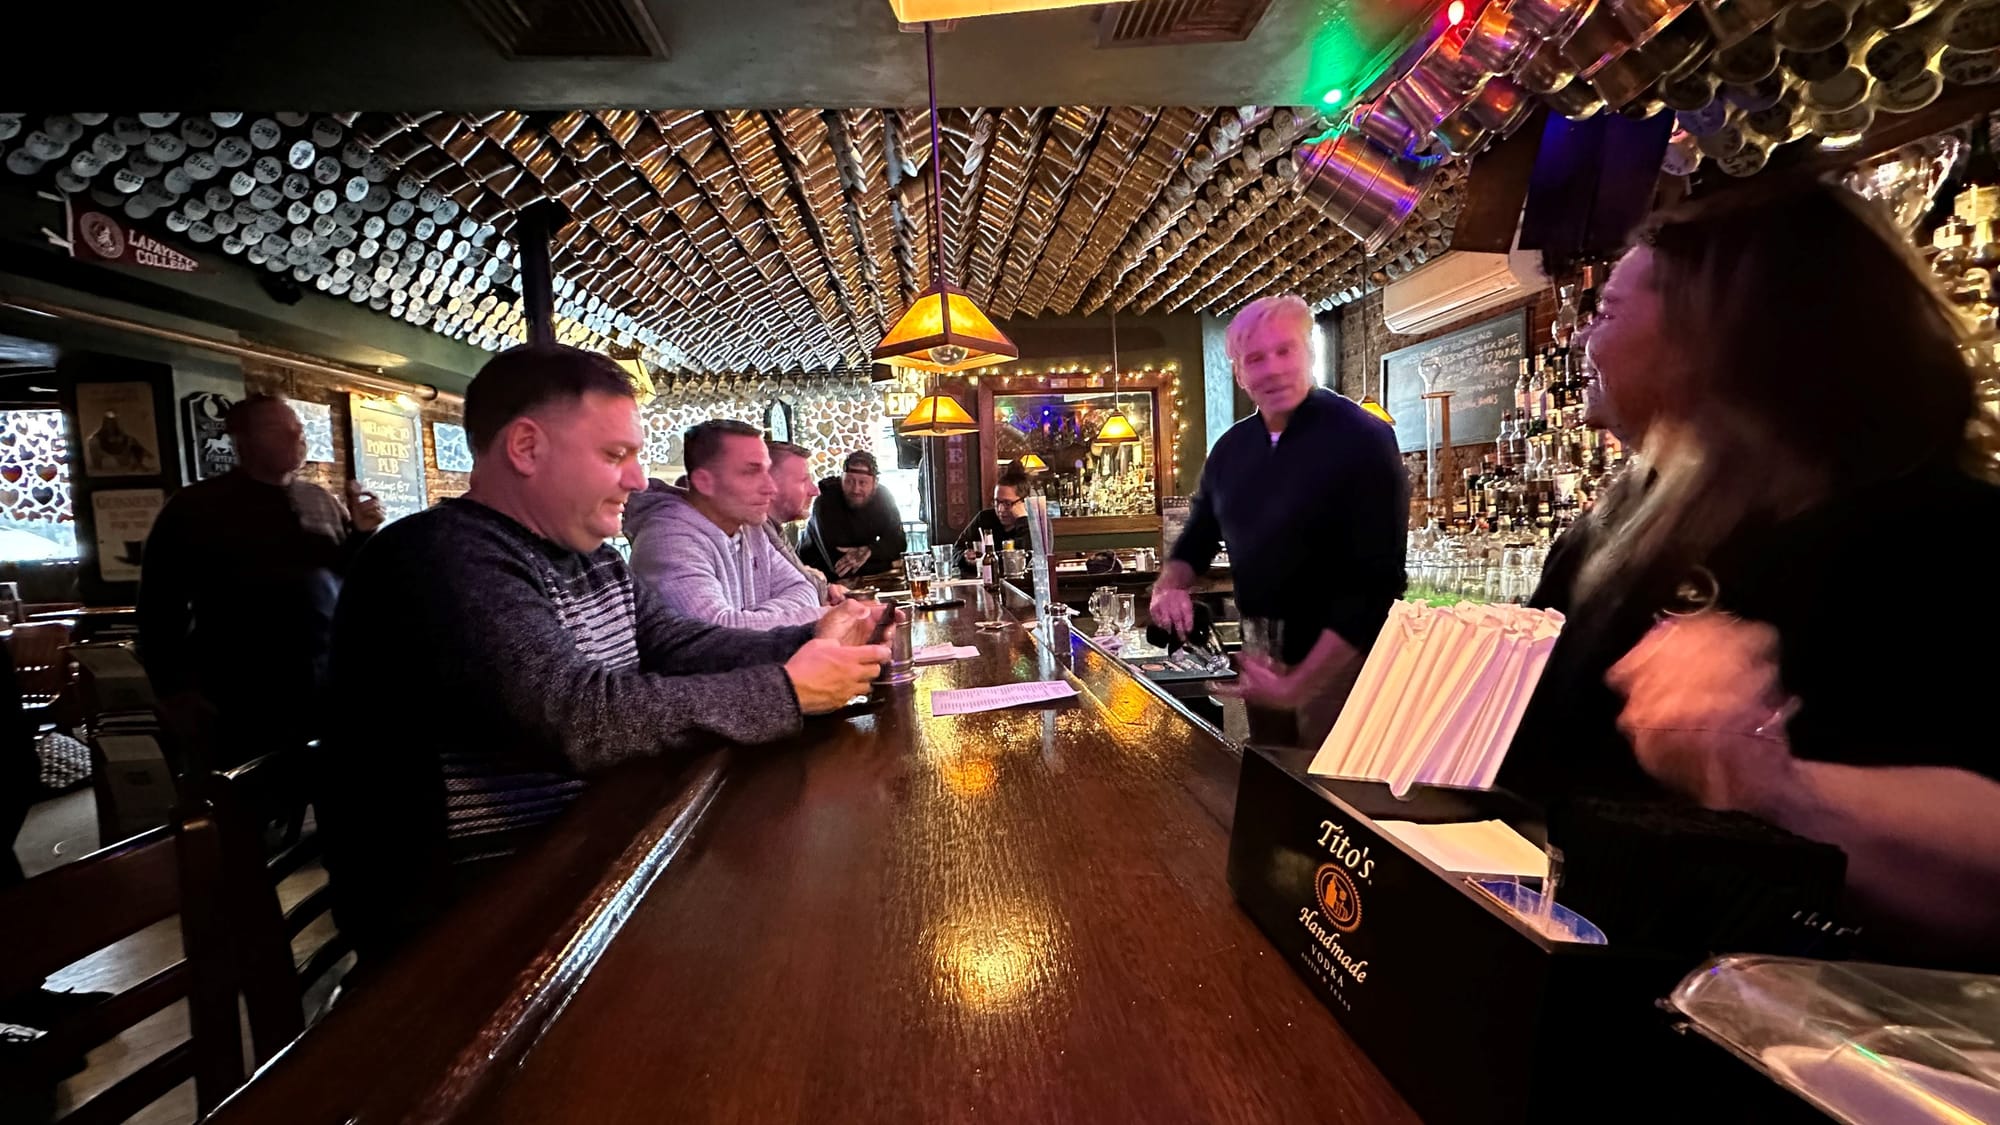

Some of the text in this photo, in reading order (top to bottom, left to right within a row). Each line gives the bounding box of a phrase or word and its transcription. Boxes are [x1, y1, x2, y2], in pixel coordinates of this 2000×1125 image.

[128, 229, 199, 268] LAFAYETTE
[136, 250, 194, 272] COLLEGE
[377, 458, 399, 474] PUB
[1317, 819, 1376, 880] Tito's
[1298, 906, 1369, 985] Handmade
[1311, 943, 1344, 988] VODKA
